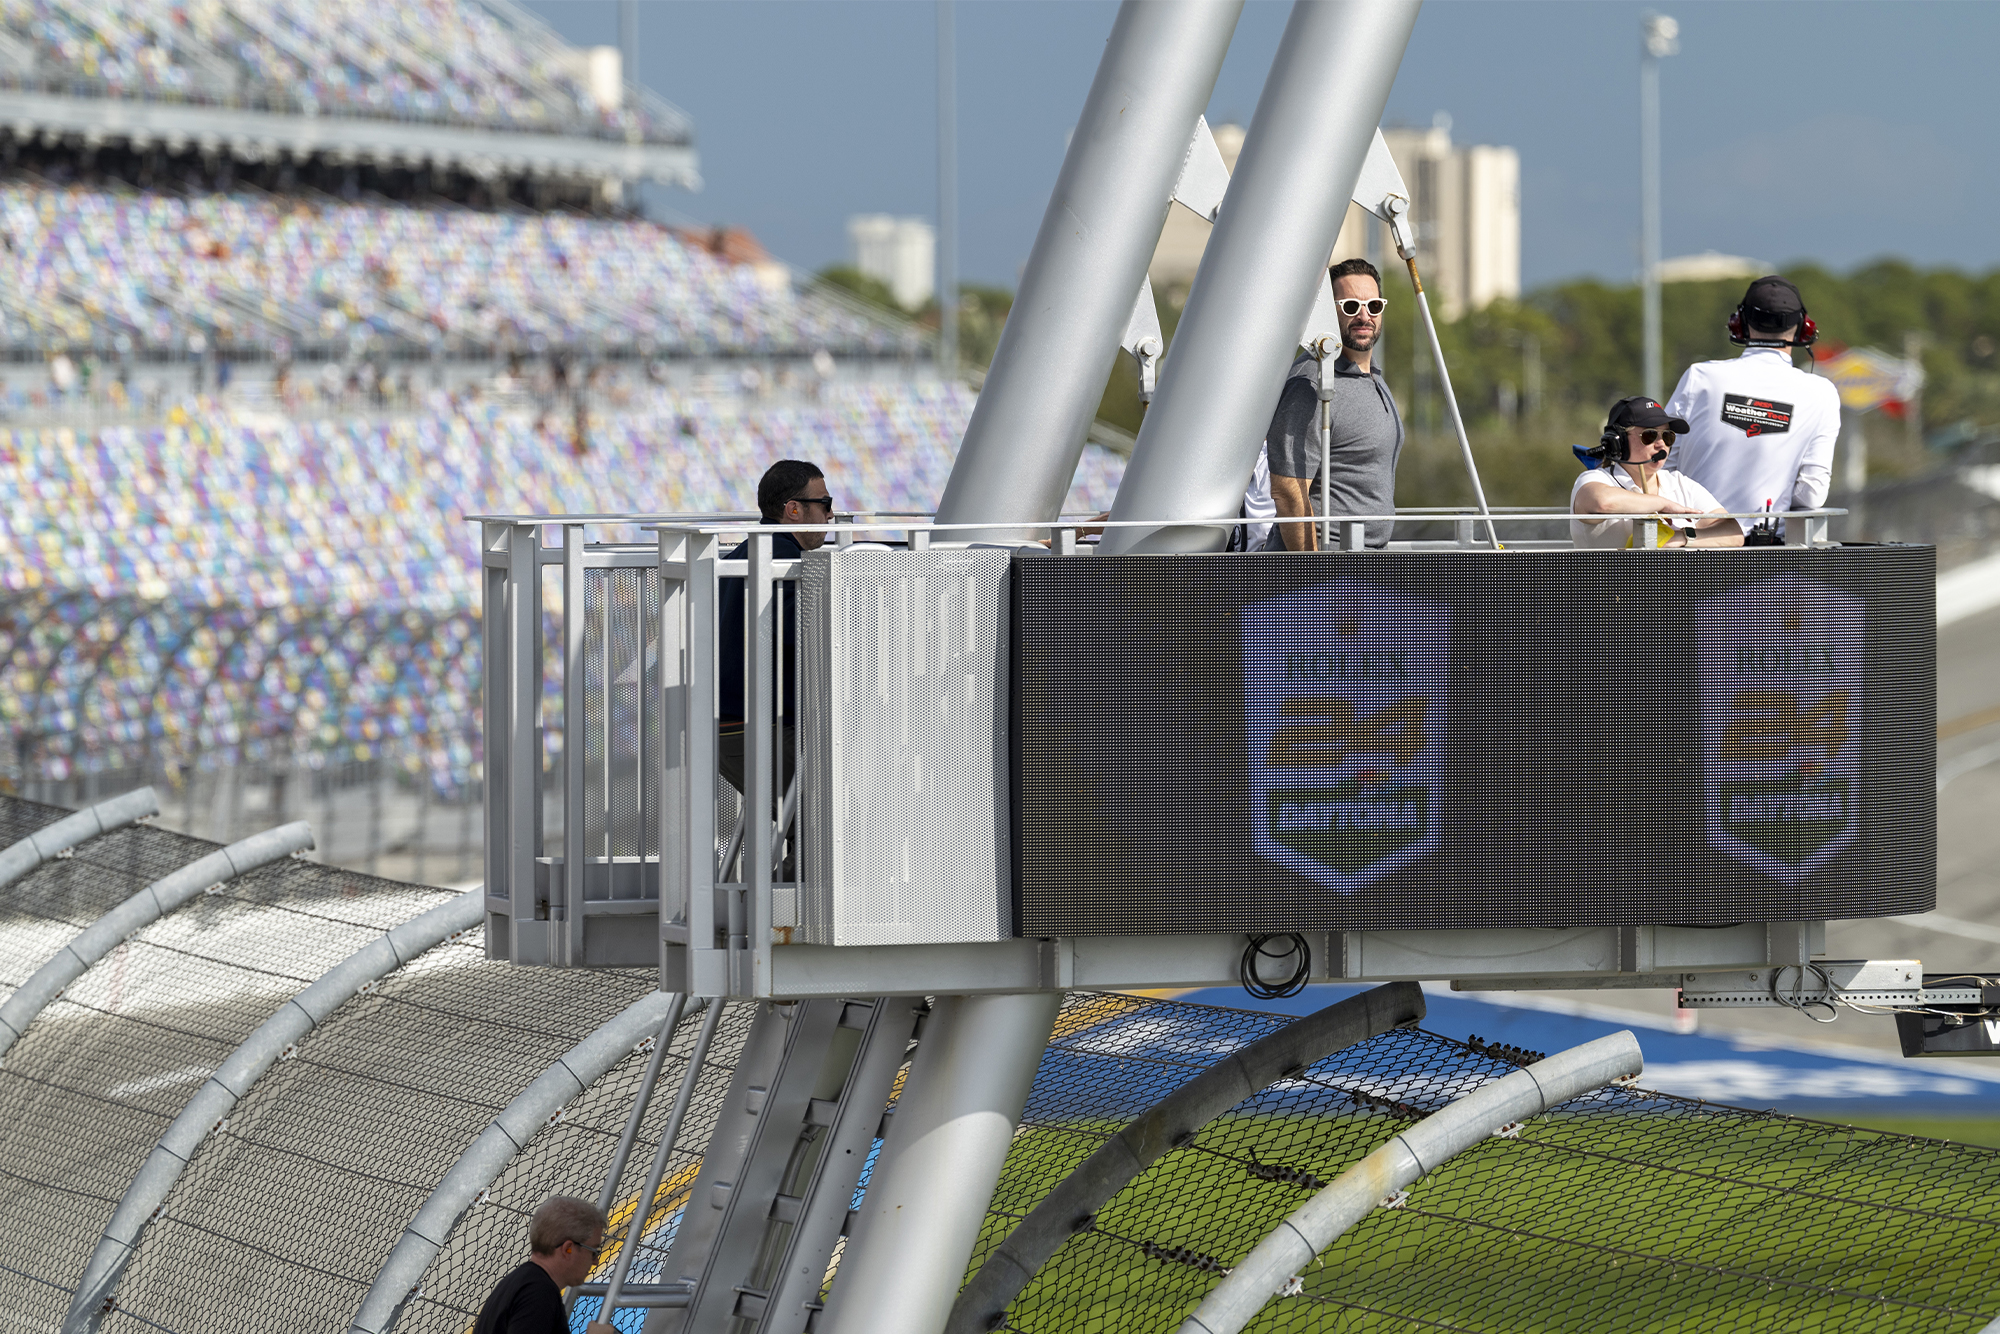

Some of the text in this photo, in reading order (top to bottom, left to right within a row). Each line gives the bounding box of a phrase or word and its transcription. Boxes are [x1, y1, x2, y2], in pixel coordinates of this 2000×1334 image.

[1725, 404, 1790, 422] WeatherTech
[1285, 652, 1409, 680] ROLEX
[1736, 645, 1836, 674] ROLEX
[1266, 695, 1430, 767] 24
[1720, 689, 1850, 760] 24
[1277, 801, 1419, 830] DAYTONA
[1729, 794, 1843, 823] DAYTONA
